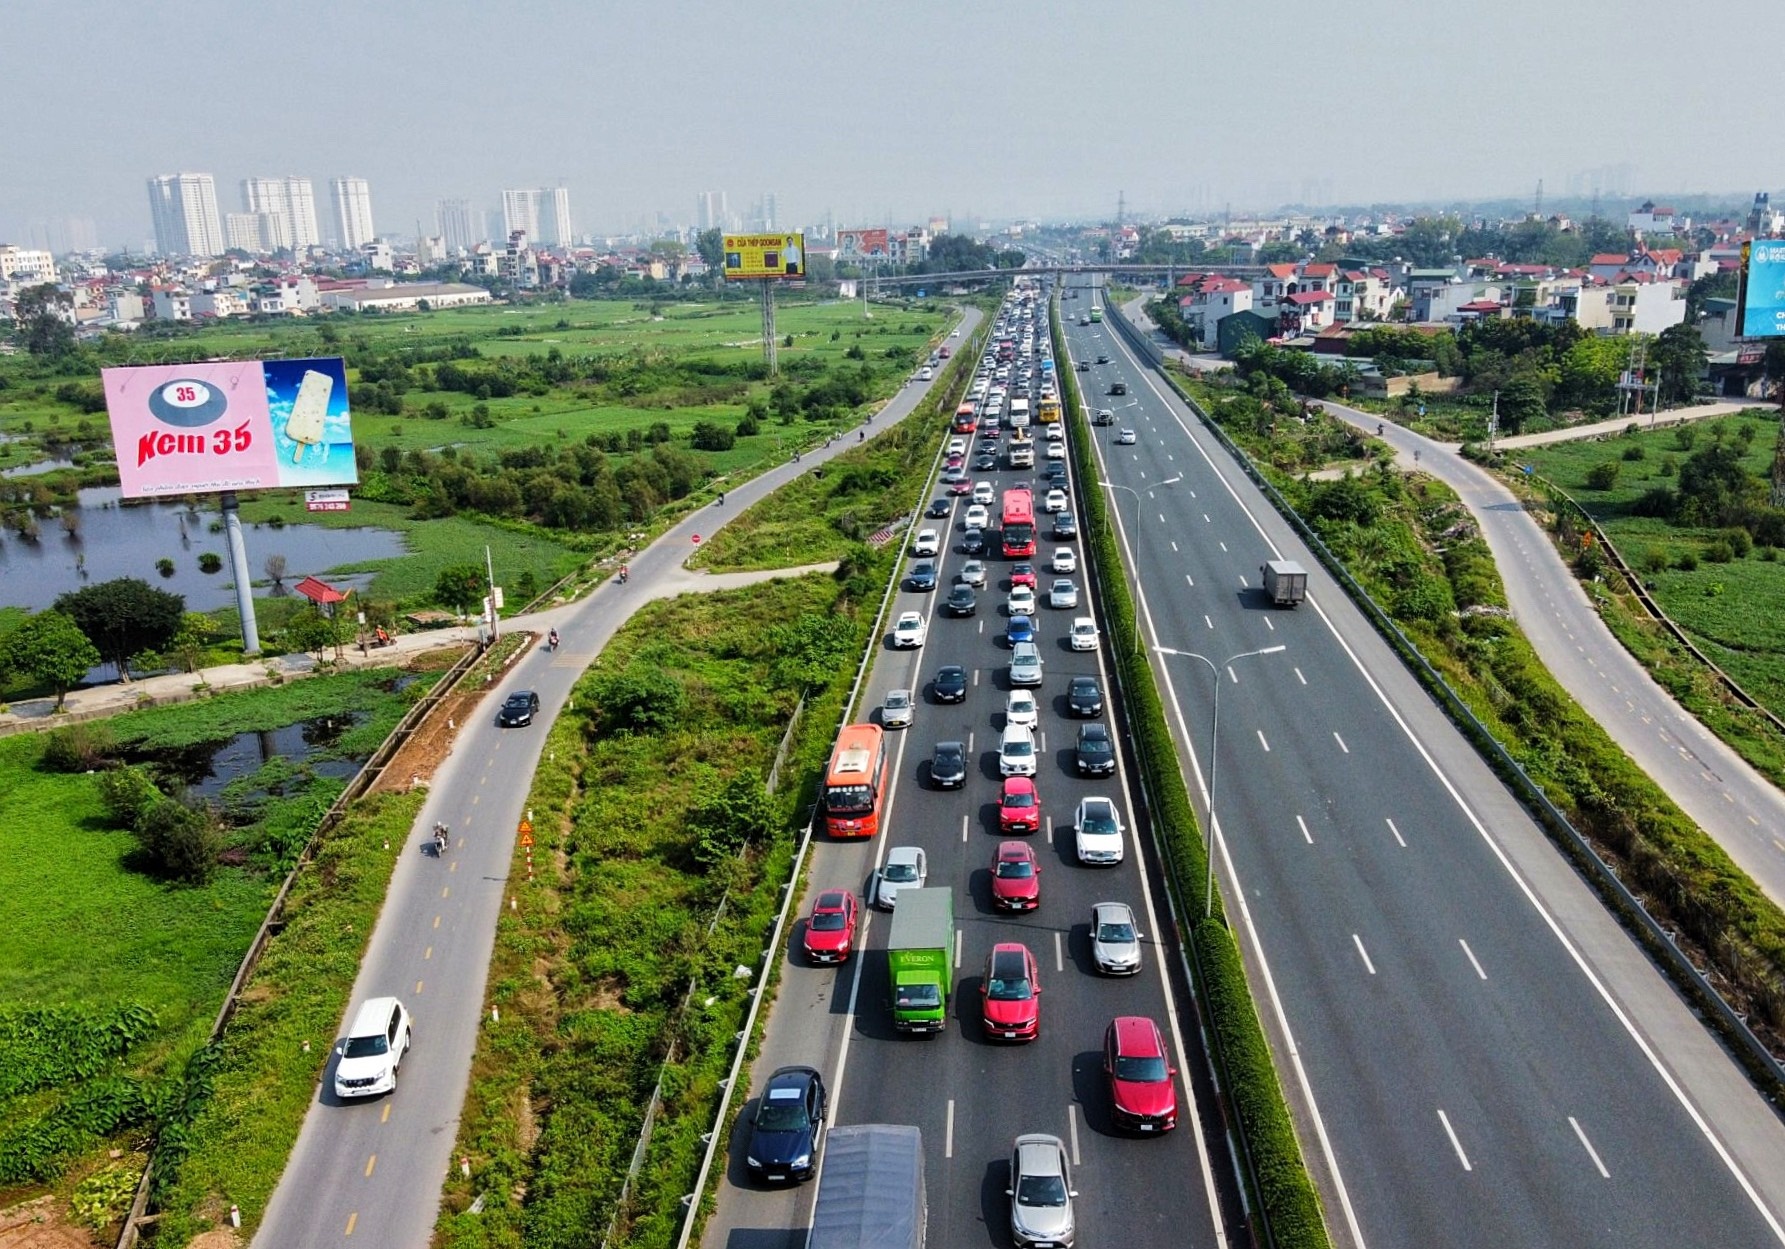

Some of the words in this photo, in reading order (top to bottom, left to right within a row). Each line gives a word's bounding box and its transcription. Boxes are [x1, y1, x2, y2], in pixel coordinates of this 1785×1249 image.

[176, 387, 196, 402] 35
[137, 430, 205, 467] Kem
[213, 418, 252, 455] 35
[900, 954, 935, 963] EVERON
